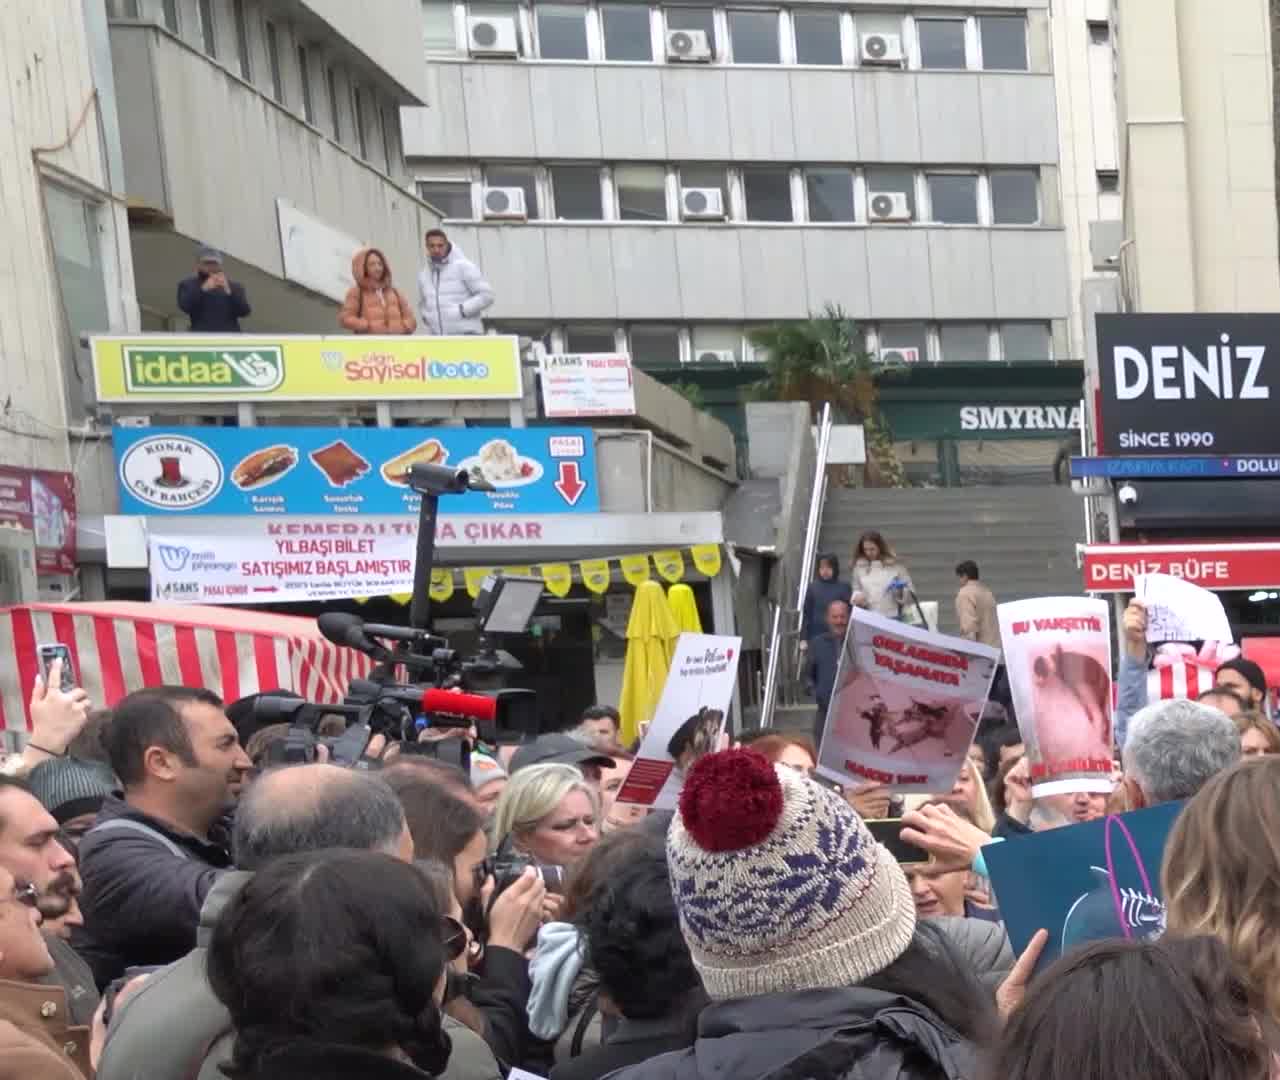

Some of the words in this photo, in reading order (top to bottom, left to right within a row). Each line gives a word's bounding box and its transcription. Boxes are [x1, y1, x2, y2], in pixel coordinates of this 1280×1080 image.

[135, 354, 232, 384] iddaa
[428, 360, 490, 380] Loto
[1113, 332, 1270, 400] DENİZ
[960, 407, 1084, 430] SMYRNA
[144, 443, 193, 454] KONAK
[1119, 429, 1170, 448] SİNCE
[1174, 431, 1214, 446] 1990
[464, 521, 543, 543] ÇIKAR
[276, 540, 333, 557] YILBAŞI
[335, 538, 375, 554] BİLET
[241, 560, 313, 579] SATIŞIMIZ
[316, 559, 412, 578] BAŞLAMIŞTIR
[1091, 560, 1161, 582] DENİZ
[1169, 558, 1230, 579] BÜFE
